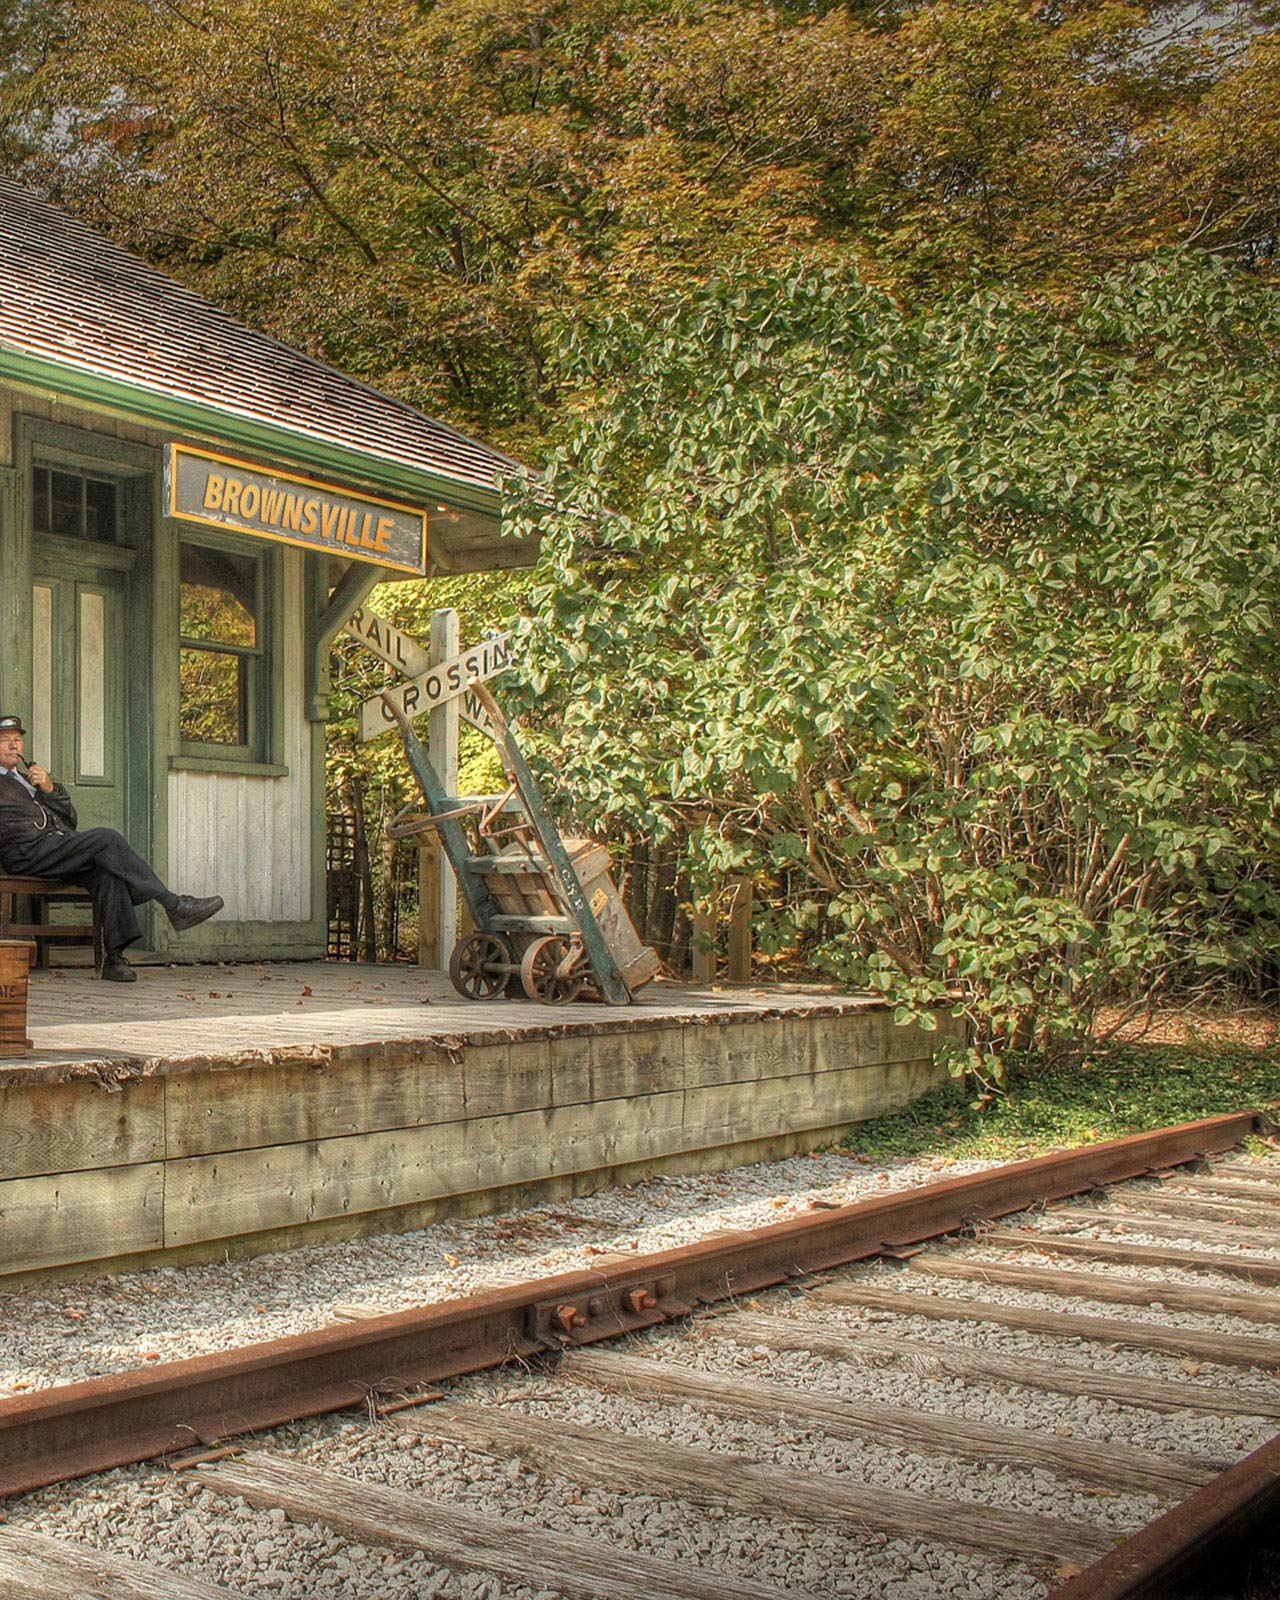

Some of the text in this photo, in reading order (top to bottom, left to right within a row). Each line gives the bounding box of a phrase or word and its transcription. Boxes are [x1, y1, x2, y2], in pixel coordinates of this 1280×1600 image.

[204, 474, 394, 552] BROWNSVILLE
[349, 608, 407, 666] RAIL
[381, 640, 509, 722] CROSSIN
